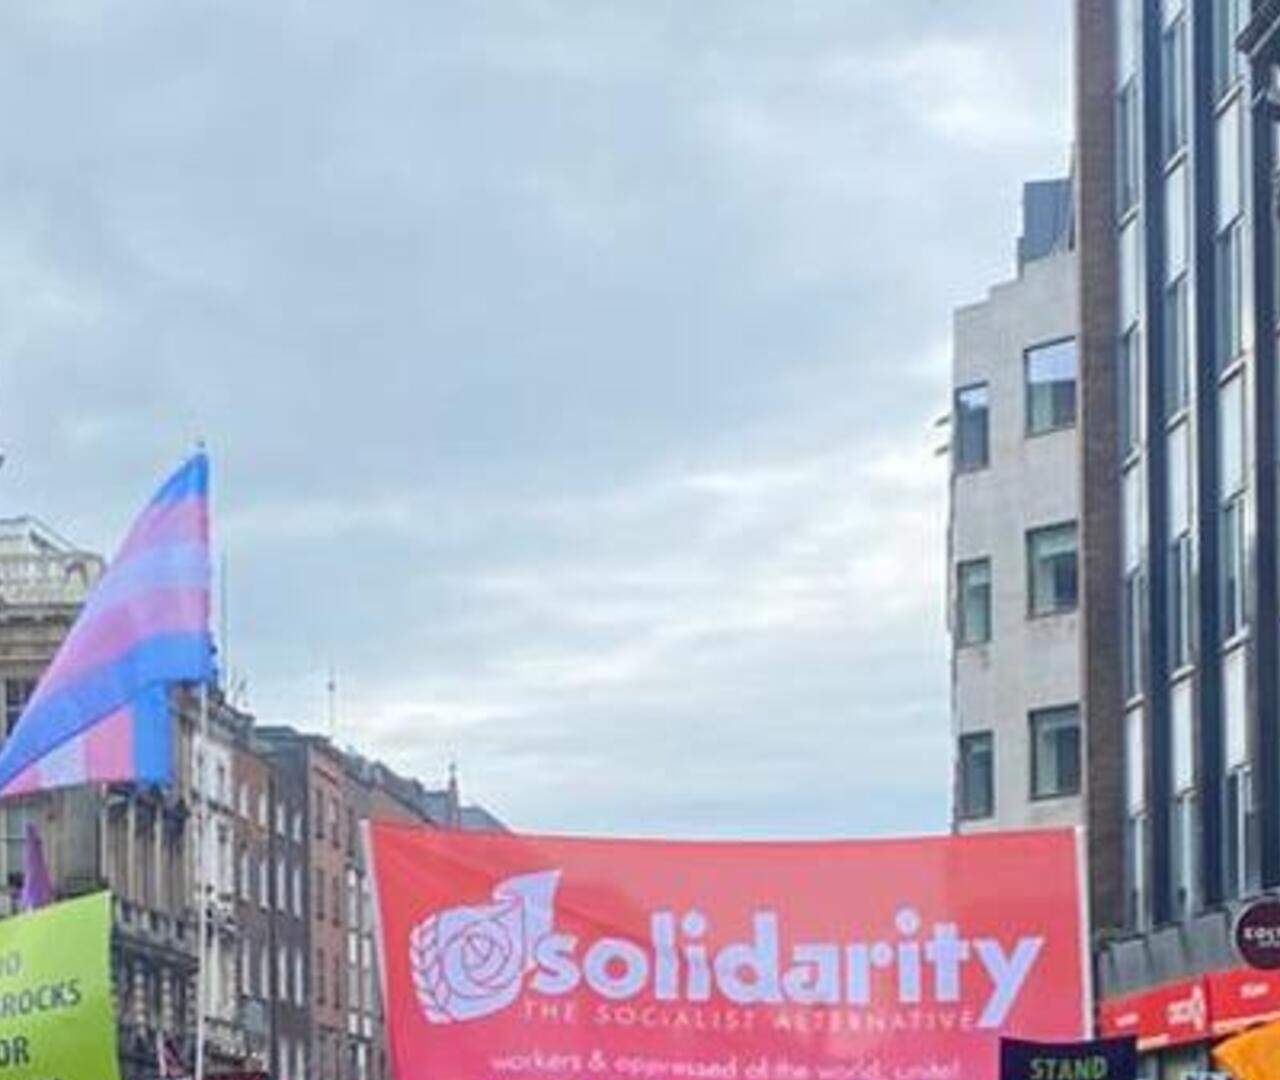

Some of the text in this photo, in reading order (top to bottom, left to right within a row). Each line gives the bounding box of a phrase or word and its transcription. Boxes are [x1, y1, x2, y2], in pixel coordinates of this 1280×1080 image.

[531, 907, 1045, 1027] solidarity
[523, 1003, 971, 1032] THE SOCIALIST ALTERNATIVE
[491, 1049, 582, 1073] workers
[588, 1051, 607, 1072] &
[613, 1055, 737, 1080] oppressed
[1029, 1056, 1108, 1080] STAND
